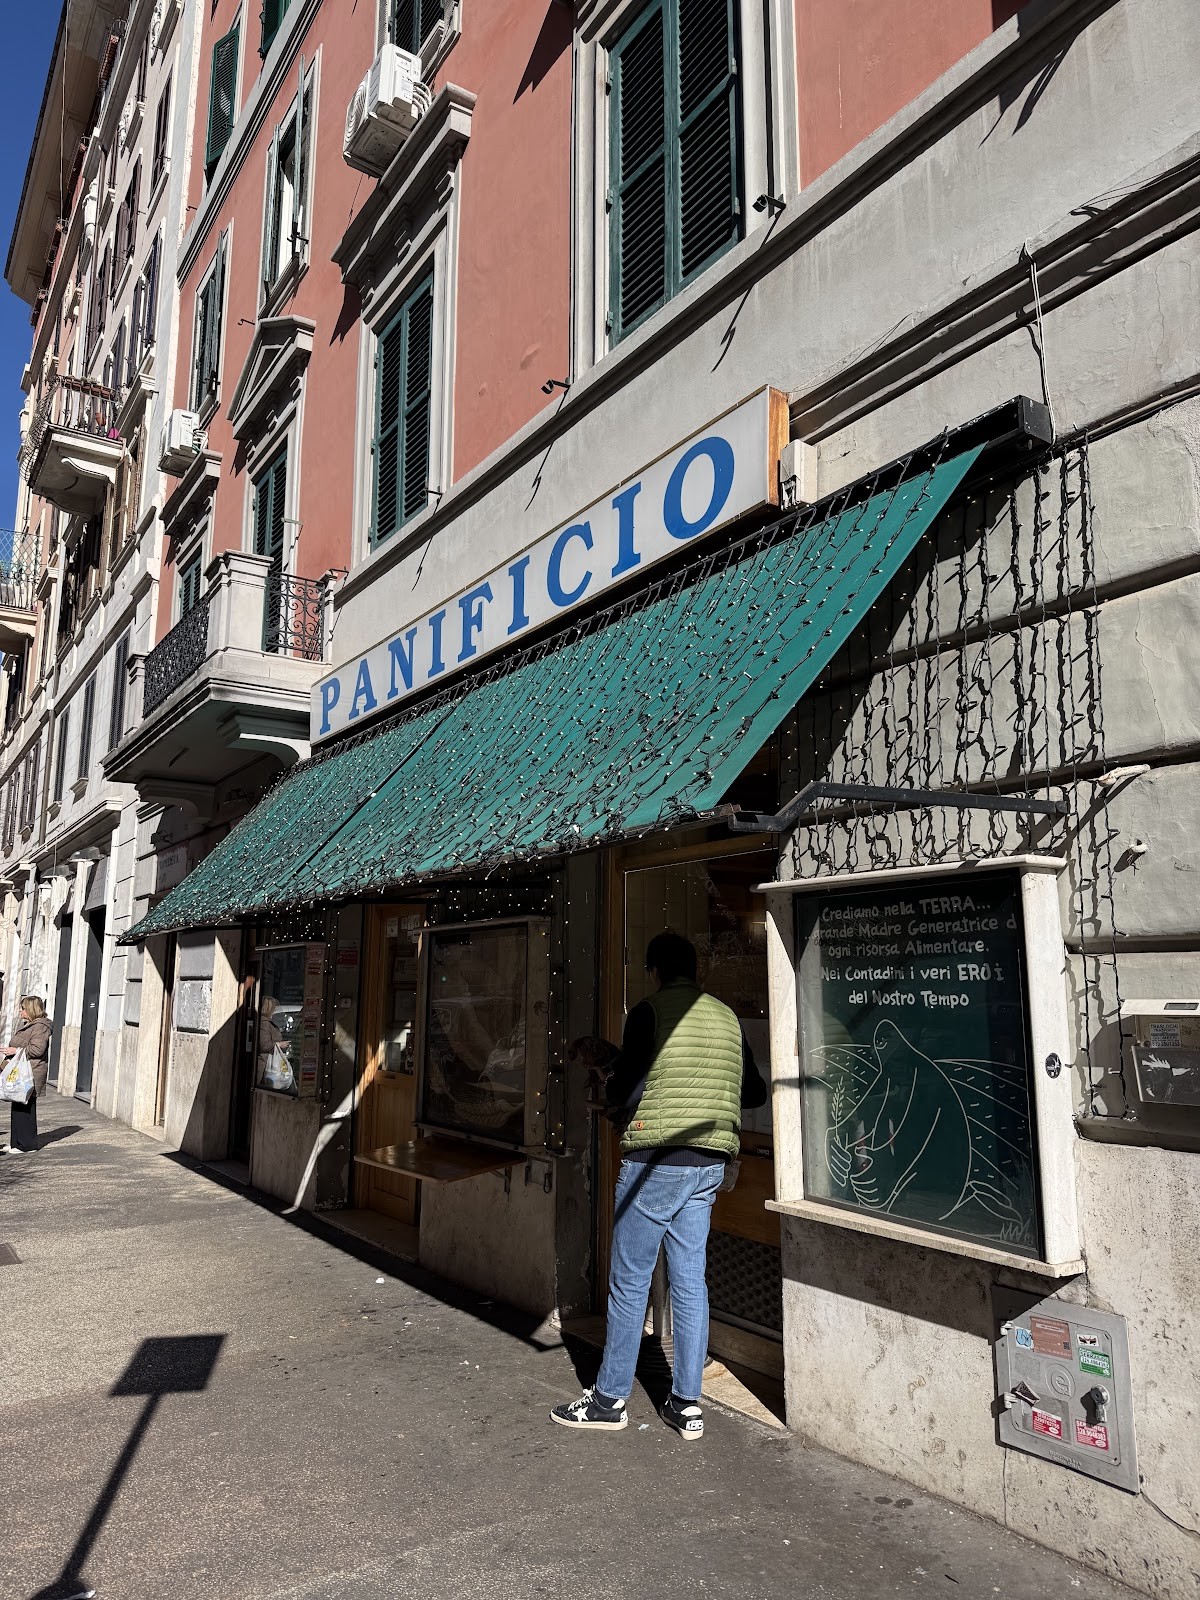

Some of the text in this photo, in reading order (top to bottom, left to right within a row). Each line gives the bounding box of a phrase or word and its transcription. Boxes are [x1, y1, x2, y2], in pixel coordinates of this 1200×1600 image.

[319, 437, 735, 736] PANIFICIO
[822, 906, 879, 921] Crediamo
[884, 901, 916, 916] nella
[859, 921, 902, 938] Madre
[907, 917, 999, 936] Generatrice
[828, 938, 990, 959] ogni risorsa Alimentare.
[820, 965, 841, 981] Nei
[845, 965, 905, 981] Contadini
[910, 966, 915, 980] i
[920, 965, 951, 980] veri
[848, 989, 970, 1009] del Nostro Tempo
